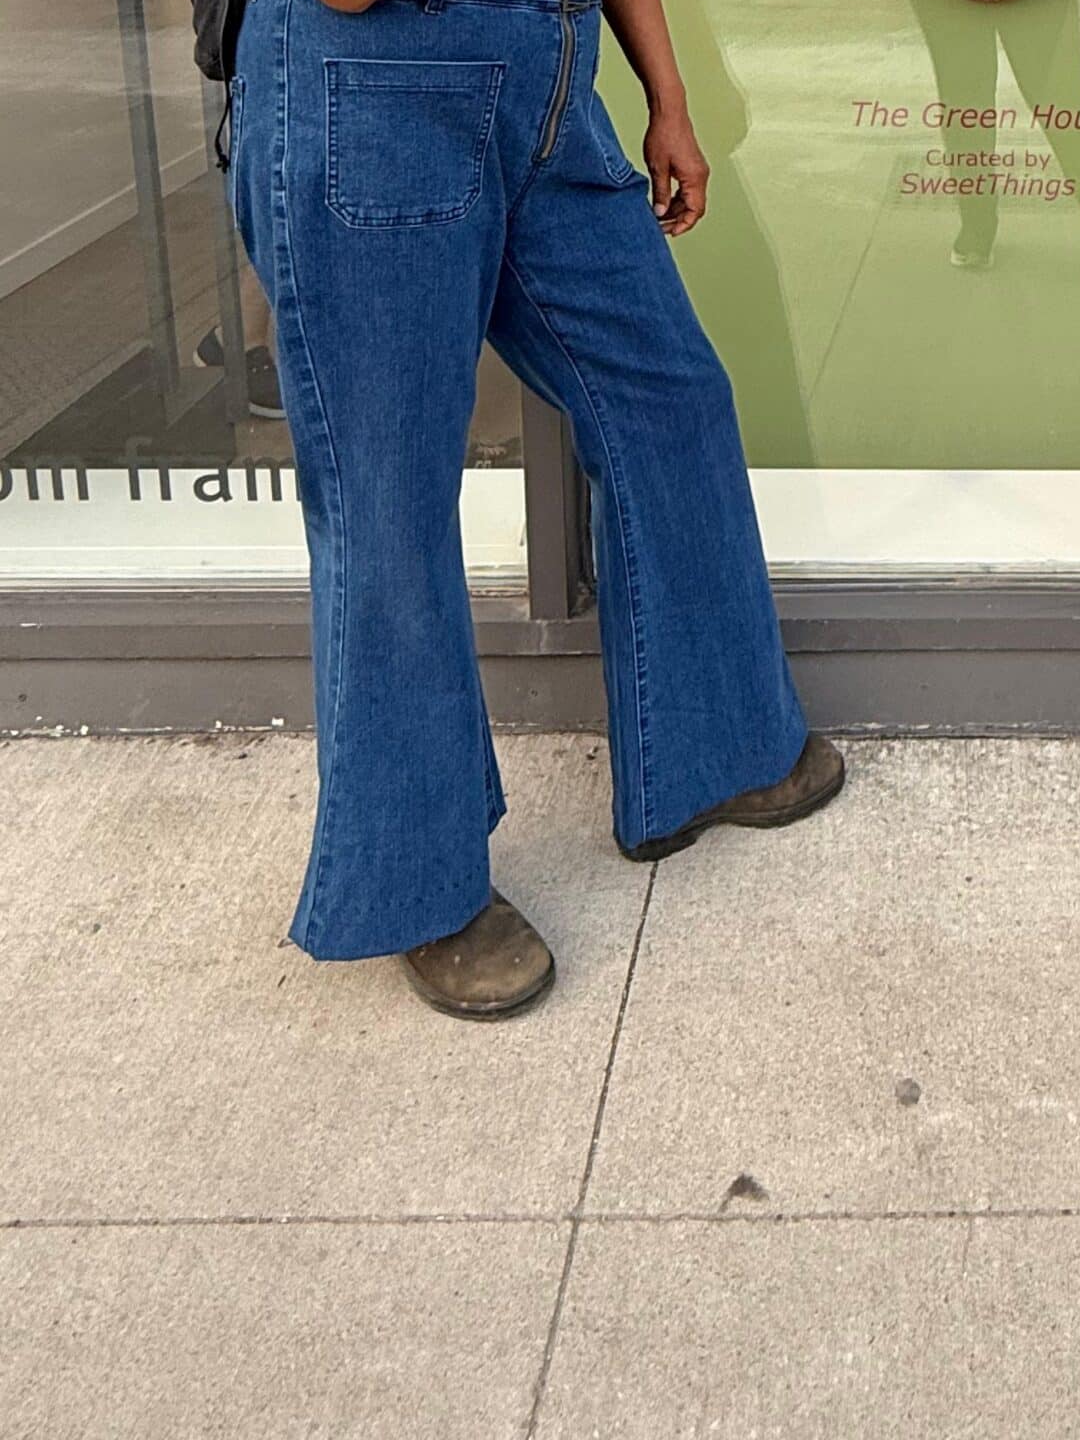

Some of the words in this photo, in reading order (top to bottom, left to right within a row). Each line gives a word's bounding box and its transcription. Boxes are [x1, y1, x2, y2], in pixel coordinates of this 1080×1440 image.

[851, 101, 909, 128] The
[922, 102, 1017, 129] Green
[926, 149, 1015, 167] Curated
[1025, 150, 1052, 170] by
[900, 172, 1076, 201] SweetThings
[117, 437, 302, 502] fram
